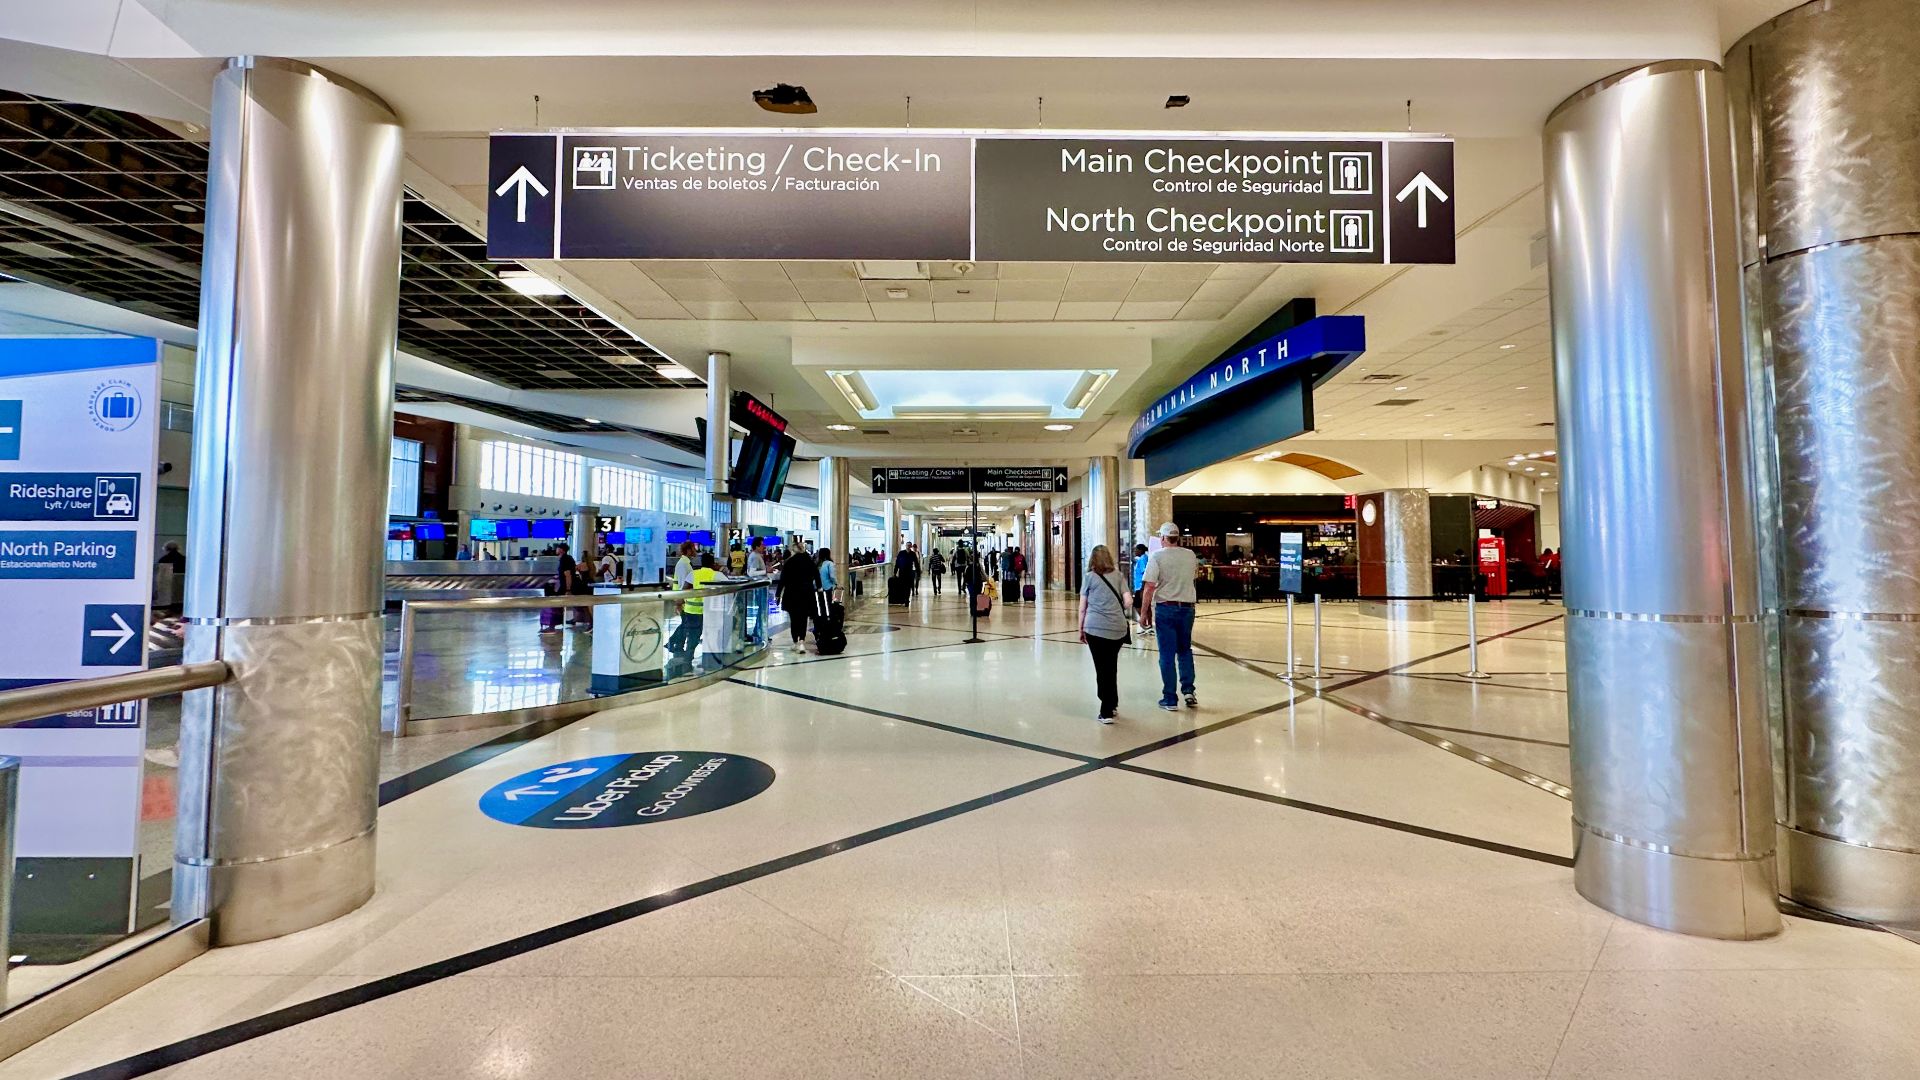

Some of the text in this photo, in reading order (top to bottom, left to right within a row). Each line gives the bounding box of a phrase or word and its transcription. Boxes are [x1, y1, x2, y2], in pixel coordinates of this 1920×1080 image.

[621, 144, 942, 176] Ticketing / Check-In
[1061, 148, 1323, 178] Main Checkpoint
[622, 176, 880, 192] Ventas de boletos / Facturación
[1152, 179, 1323, 196] Control de Seguridad
[1046, 207, 1326, 238] North Checkpoint
[1102, 237, 1325, 255] Control de Seguridad Norte
[1141, 339, 1288, 429] TERMINAL NORTH
[899, 469, 929, 477] Ticketing
[1004, 468, 1042, 476] Checkpoint
[9, 483, 92, 498] Rideshare
[1004, 480, 1042, 488] Checkpoint
[44, 501, 62, 511] Lyft
[70, 501, 92, 509] Uber
[600, 517, 612, 532] 3
[732, 530, 740, 540] 2
[1, 541, 117, 559] North Parking
[0, 560, 97, 569] Estacionamiento Norte
[553, 754, 683, 821] Uber Pickup
[636, 757, 727, 817] Go downstairs
